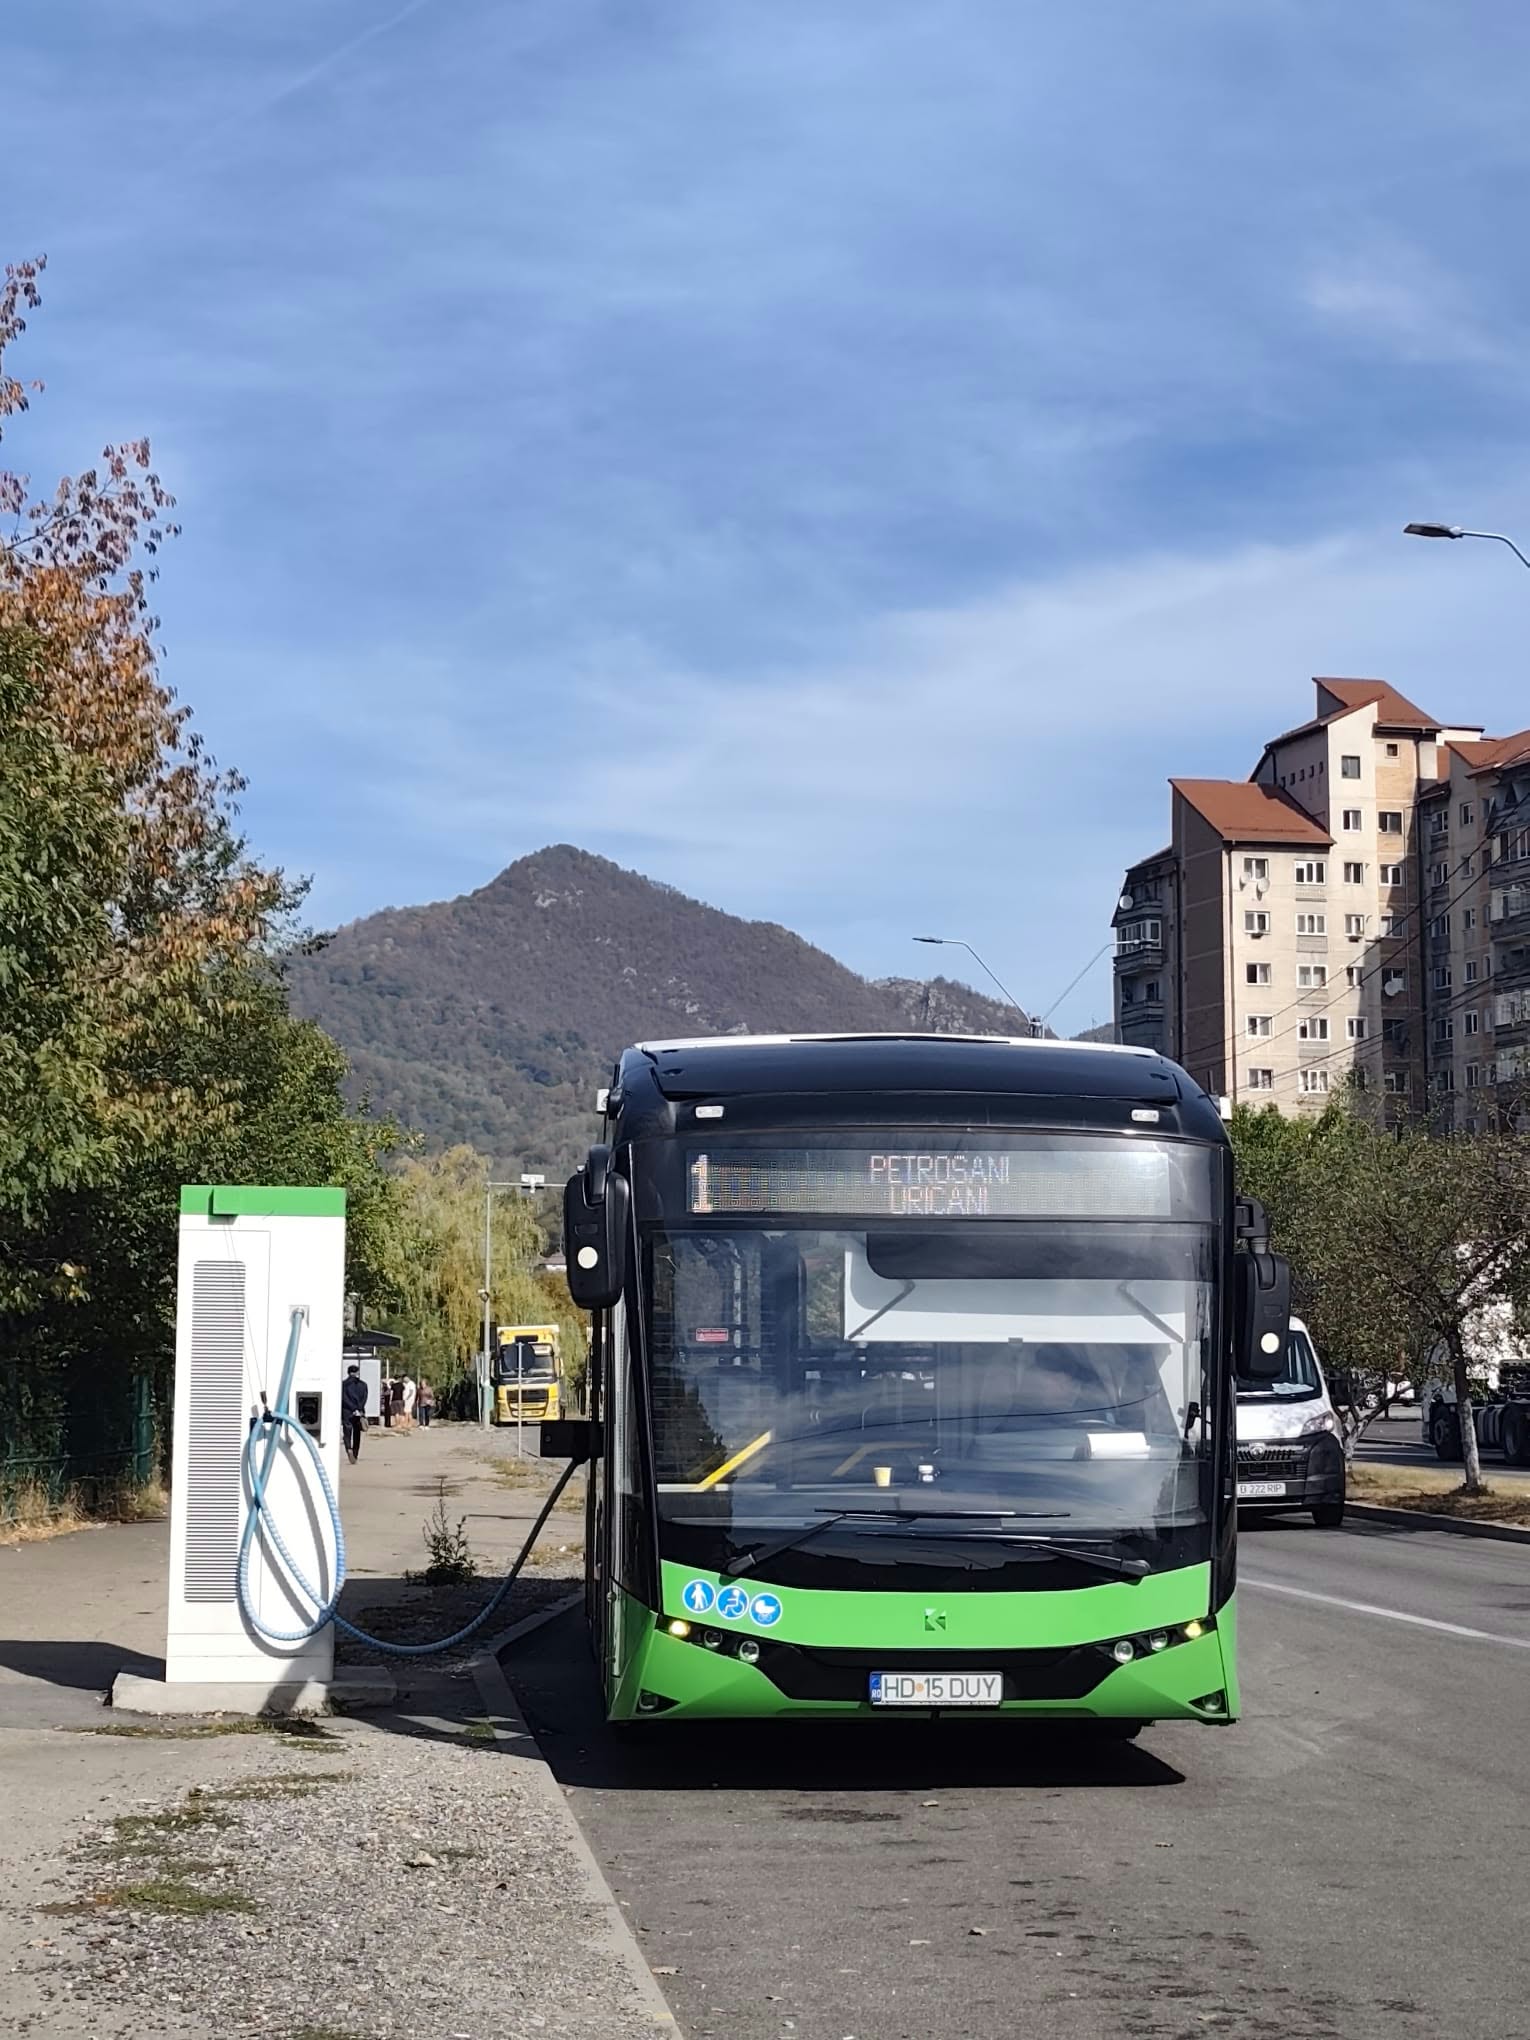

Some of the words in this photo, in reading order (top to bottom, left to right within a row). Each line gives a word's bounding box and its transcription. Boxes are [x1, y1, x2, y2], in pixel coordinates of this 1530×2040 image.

[690, 1154, 713, 1213] 1
[889, 1186, 989, 1215] URICANI
[1267, 1483, 1282, 1493] RIP
[884, 1677, 916, 1699] HD
[923, 1677, 945, 1699] 15
[948, 1677, 997, 1699] DUY
